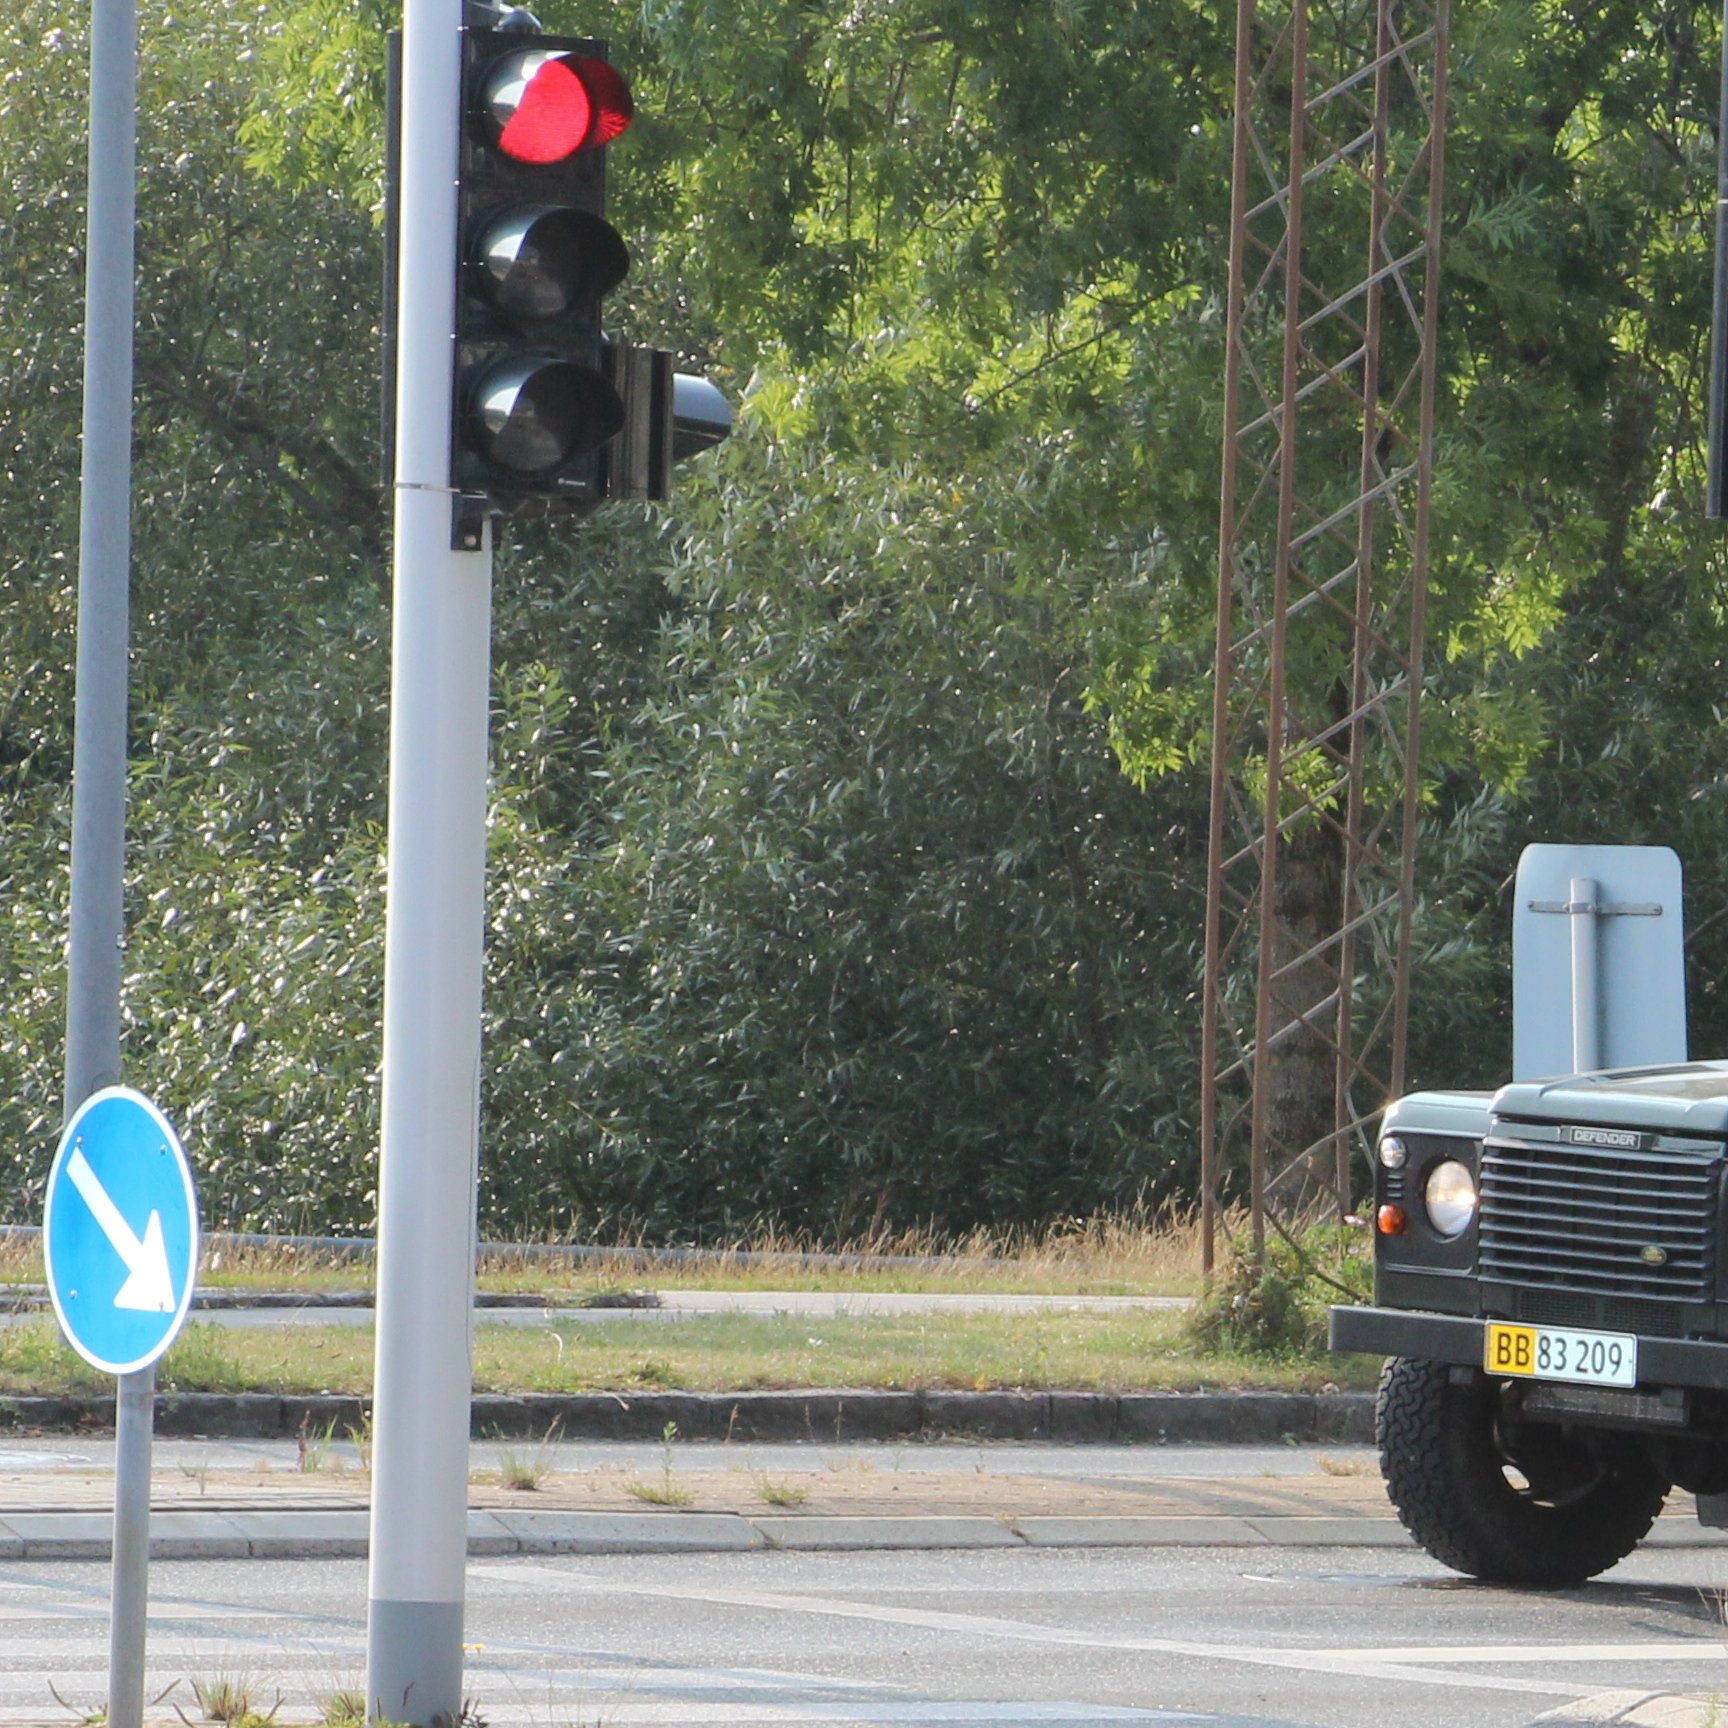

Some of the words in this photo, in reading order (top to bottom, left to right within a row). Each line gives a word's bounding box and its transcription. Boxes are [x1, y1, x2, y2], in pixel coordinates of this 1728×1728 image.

[1573, 1130, 1636, 1146] DEFENDER
[1496, 1332, 1530, 1366] BB
[1537, 1335, 1567, 1371] 83
[1575, 1340, 1622, 1376] 209
